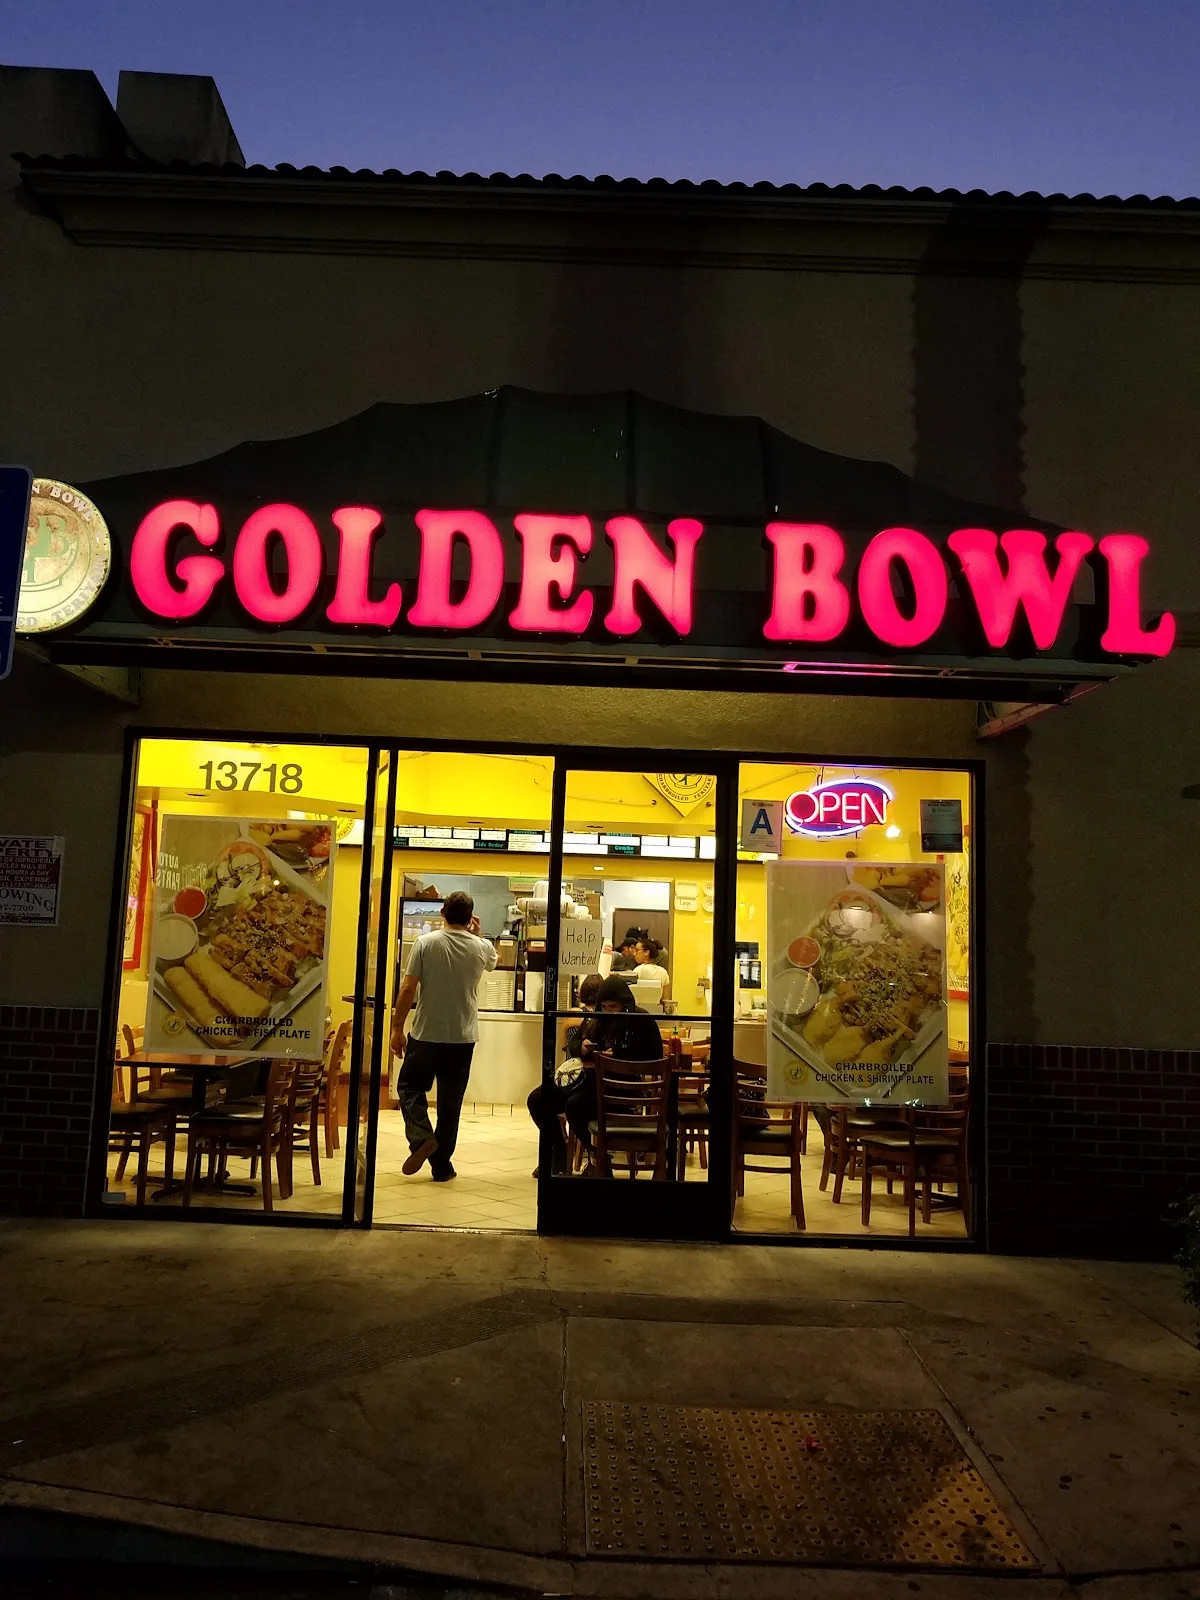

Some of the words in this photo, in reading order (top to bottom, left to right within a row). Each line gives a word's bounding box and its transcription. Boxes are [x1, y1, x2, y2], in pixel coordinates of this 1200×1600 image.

[50, 485, 94, 522] BOWL
[130, 500, 703, 636] GOLDEN
[763, 522, 1176, 658] BOWL
[199, 760, 303, 794] 13718
[786, 790, 887, 824] OPEN
[750, 808, 773, 835] A
[566, 927, 596, 948] Help
[561, 948, 598, 966] Wanted
[214, 1015, 293, 1027] CHARBROILED
[196, 1026, 240, 1036] CHICKEN
[254, 1029, 276, 1038] FISH
[279, 1029, 311, 1039] PLATE
[835, 1062, 914, 1072] CHARBROILED
[815, 1073, 855, 1083] CHICKEN
[858, 1074, 864, 1083] &
[906, 1075, 934, 1085] PLATE
